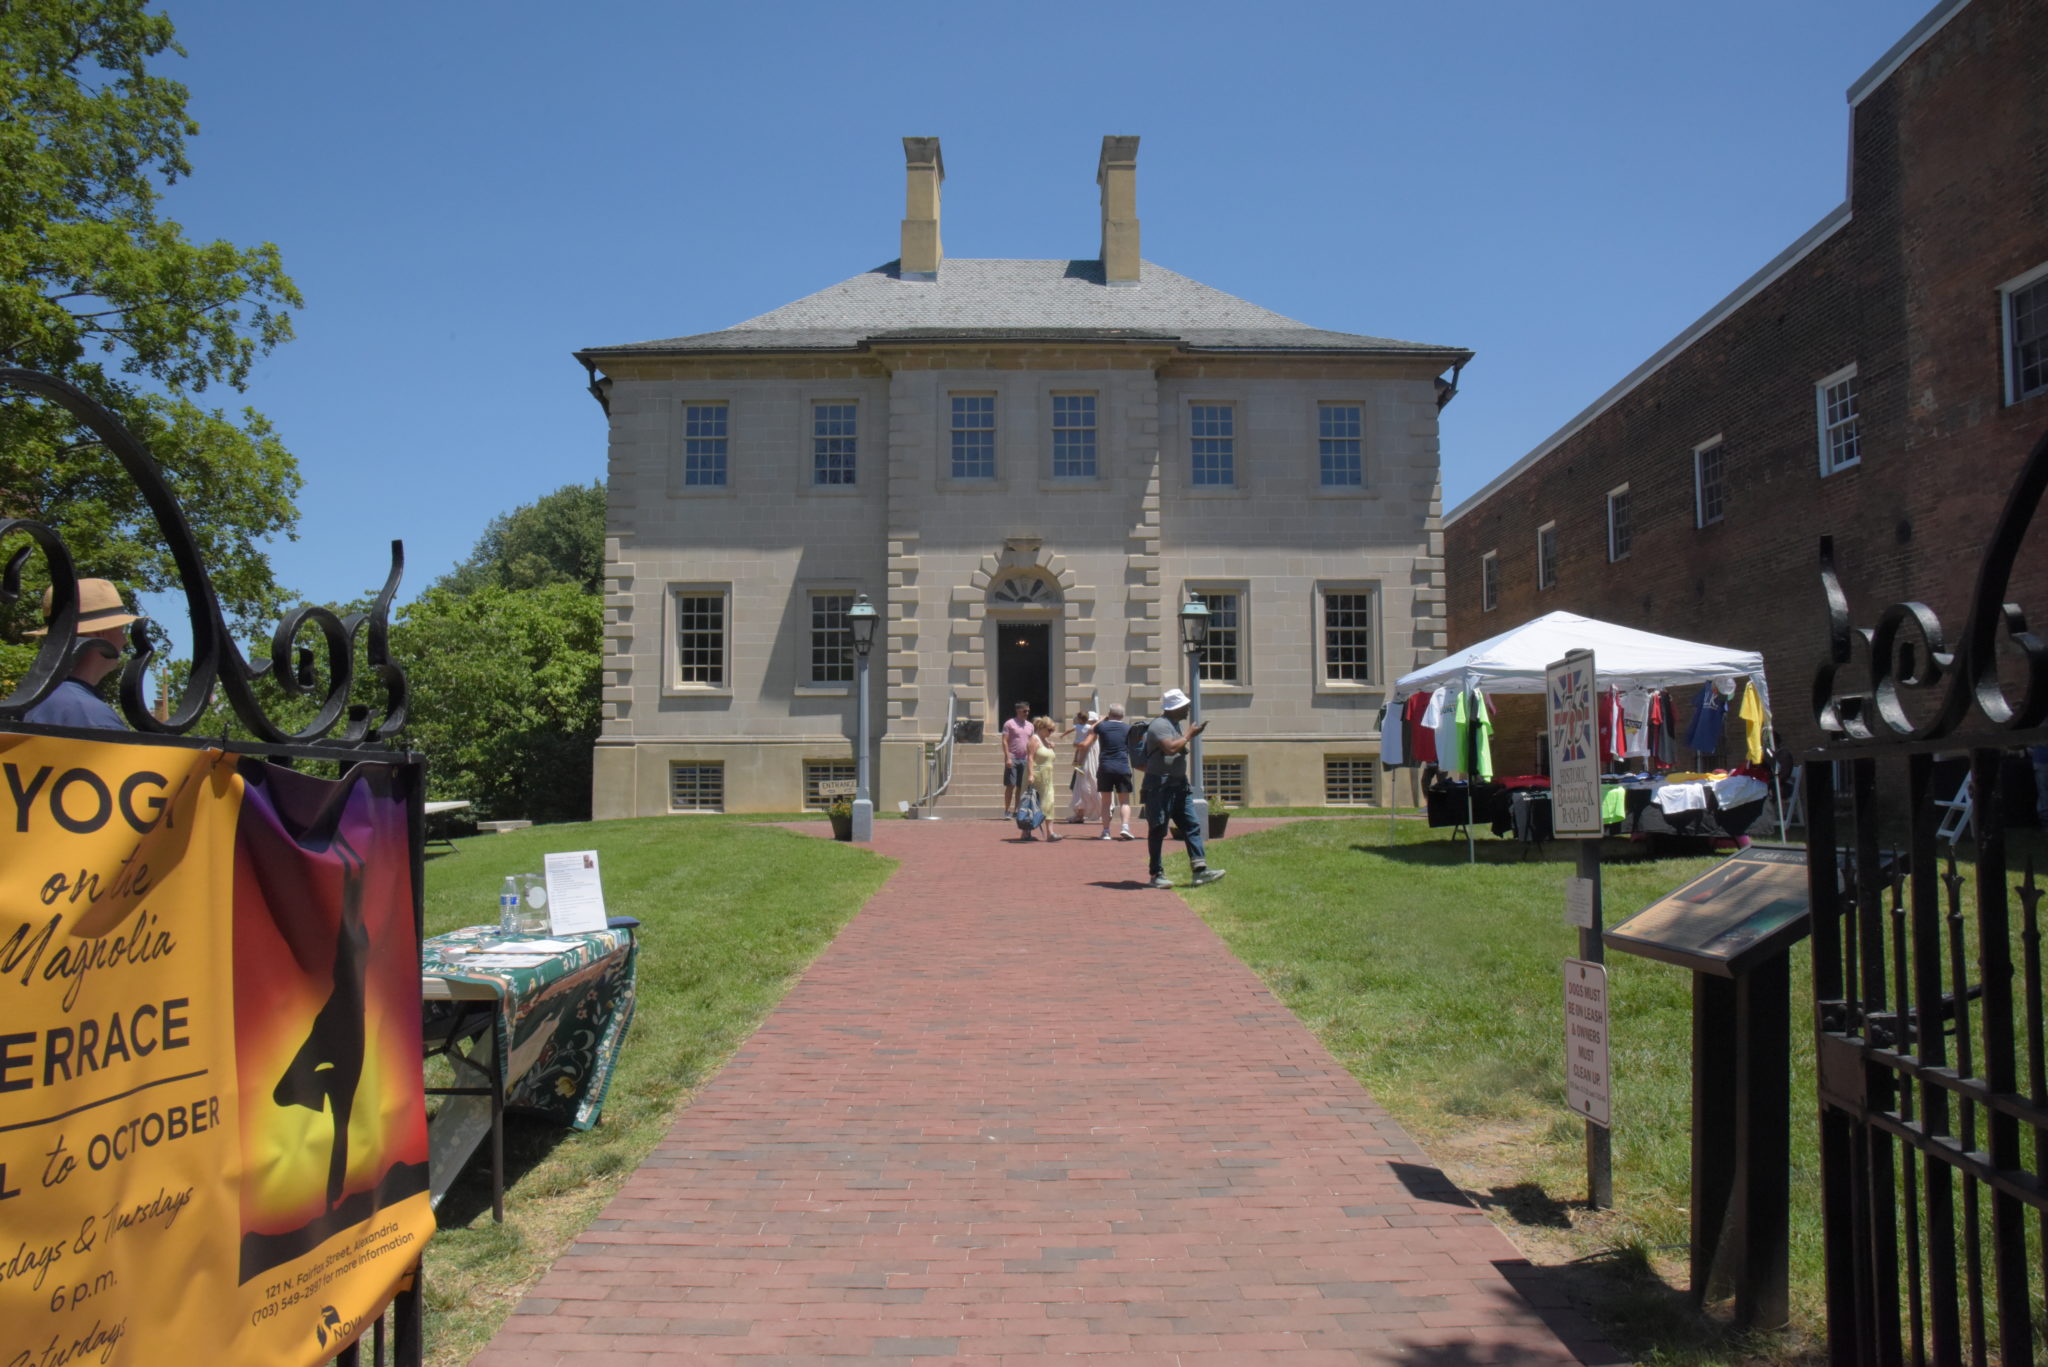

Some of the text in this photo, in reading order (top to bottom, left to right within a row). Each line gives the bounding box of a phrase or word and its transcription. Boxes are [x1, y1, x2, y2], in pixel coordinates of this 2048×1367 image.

[1554, 683, 1590, 748] 1755
[822, 781, 855, 789] ENTRANCE
[1560, 765, 1587, 784] HISTORIC
[1557, 782, 1594, 807] BRADDOCK
[40, 842, 152, 905] on te
[0, 910, 177, 1013] Magnolia
[1568, 982, 1600, 1001] DOGS MUST
[1568, 1001, 1575, 1015] BE
[1584, 1006, 1602, 1024] LEASH
[1577, 1024, 1600, 1044] OWNERS
[1578, 1045, 1594, 1062] MUST
[1573, 1063, 1591, 1082] CLEAN
[42, 1134, 80, 1187] to
[87, 1095, 220, 1171] OCTOBER
[73, 1215, 96, 1254] &
[102, 1187, 194, 1244] Tursdays
[265, 1282, 281, 1299] 121
[296, 1262, 325, 1286] Fairfax
[354, 1222, 399, 1251] Alexandria
[51, 1270, 117, 1312] 6 p.m.
[252, 1301, 279, 1327] (703)
[322, 1271, 334, 1288] for
[335, 1259, 357, 1278] more
[358, 1231, 415, 1266] information
